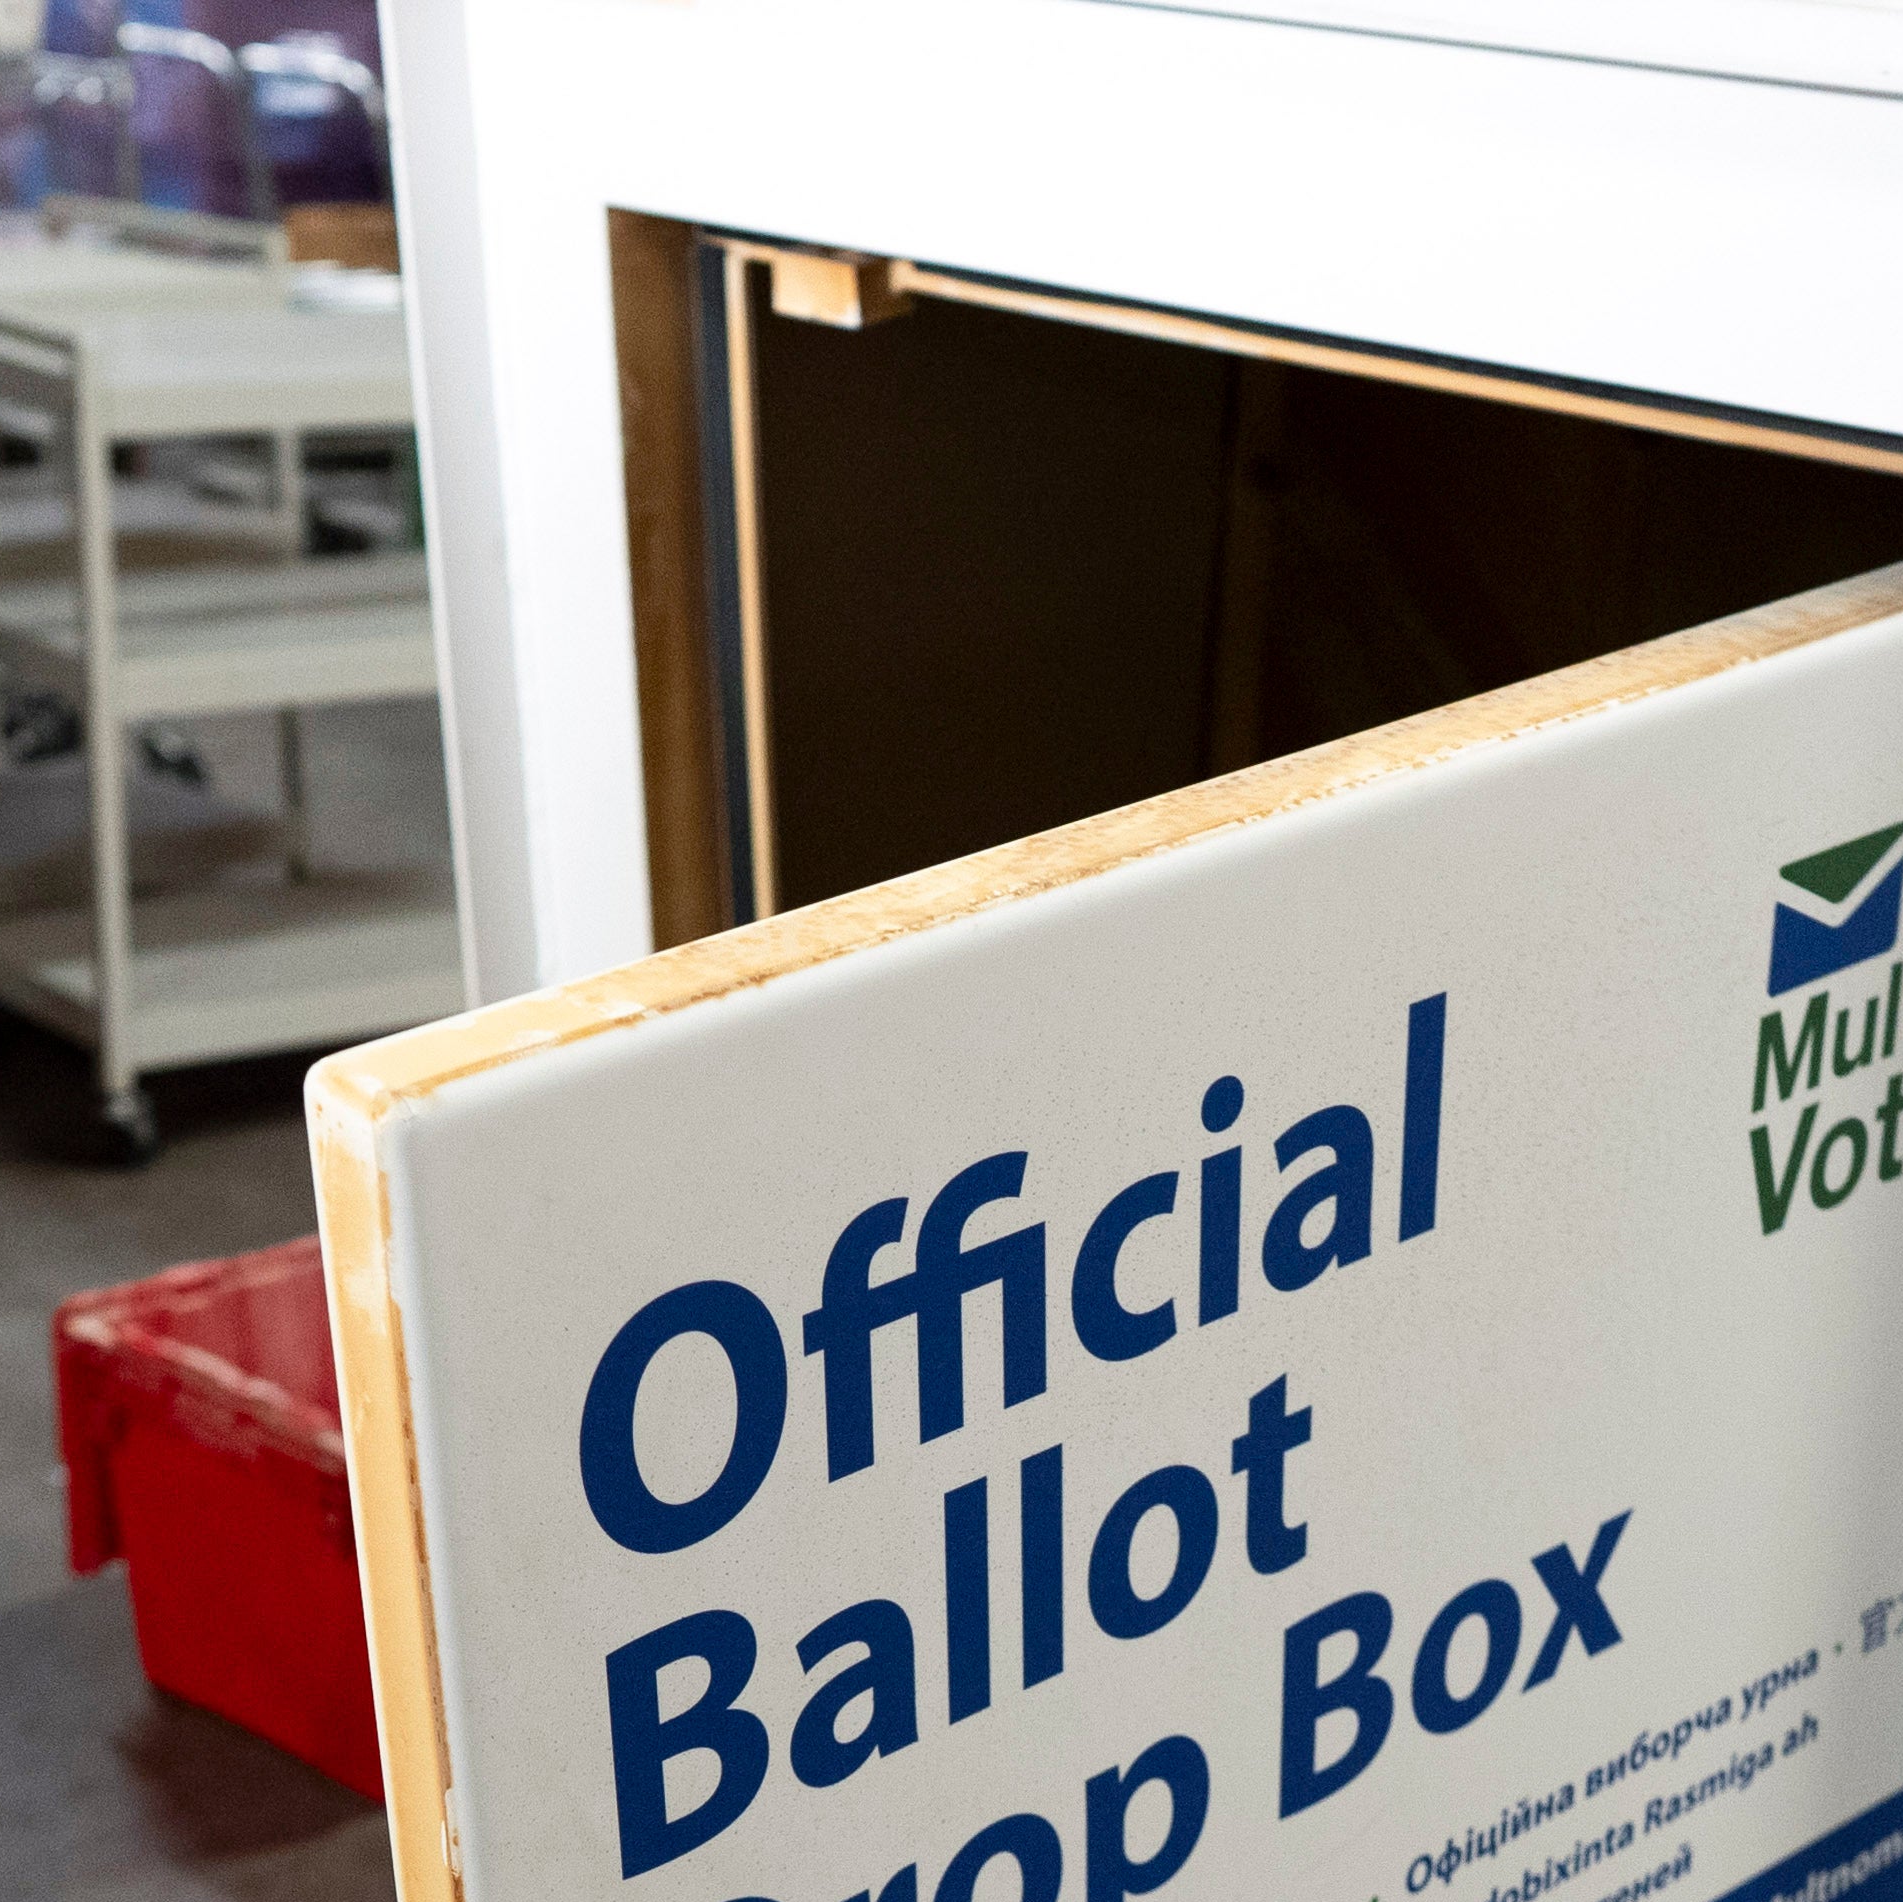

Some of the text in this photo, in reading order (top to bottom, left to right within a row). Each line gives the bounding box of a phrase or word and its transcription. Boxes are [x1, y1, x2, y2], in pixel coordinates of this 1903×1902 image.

[579, 991, 1448, 1555] Official
[605, 1372, 1313, 1880] Ballot
[1278, 1507, 1633, 1820] Box
[1406, 1649, 1820, 1893] Офіційна виборча урна
[1643, 1740, 1775, 1835] Rasmiga
[1782, 1714, 1818, 1758] ah
